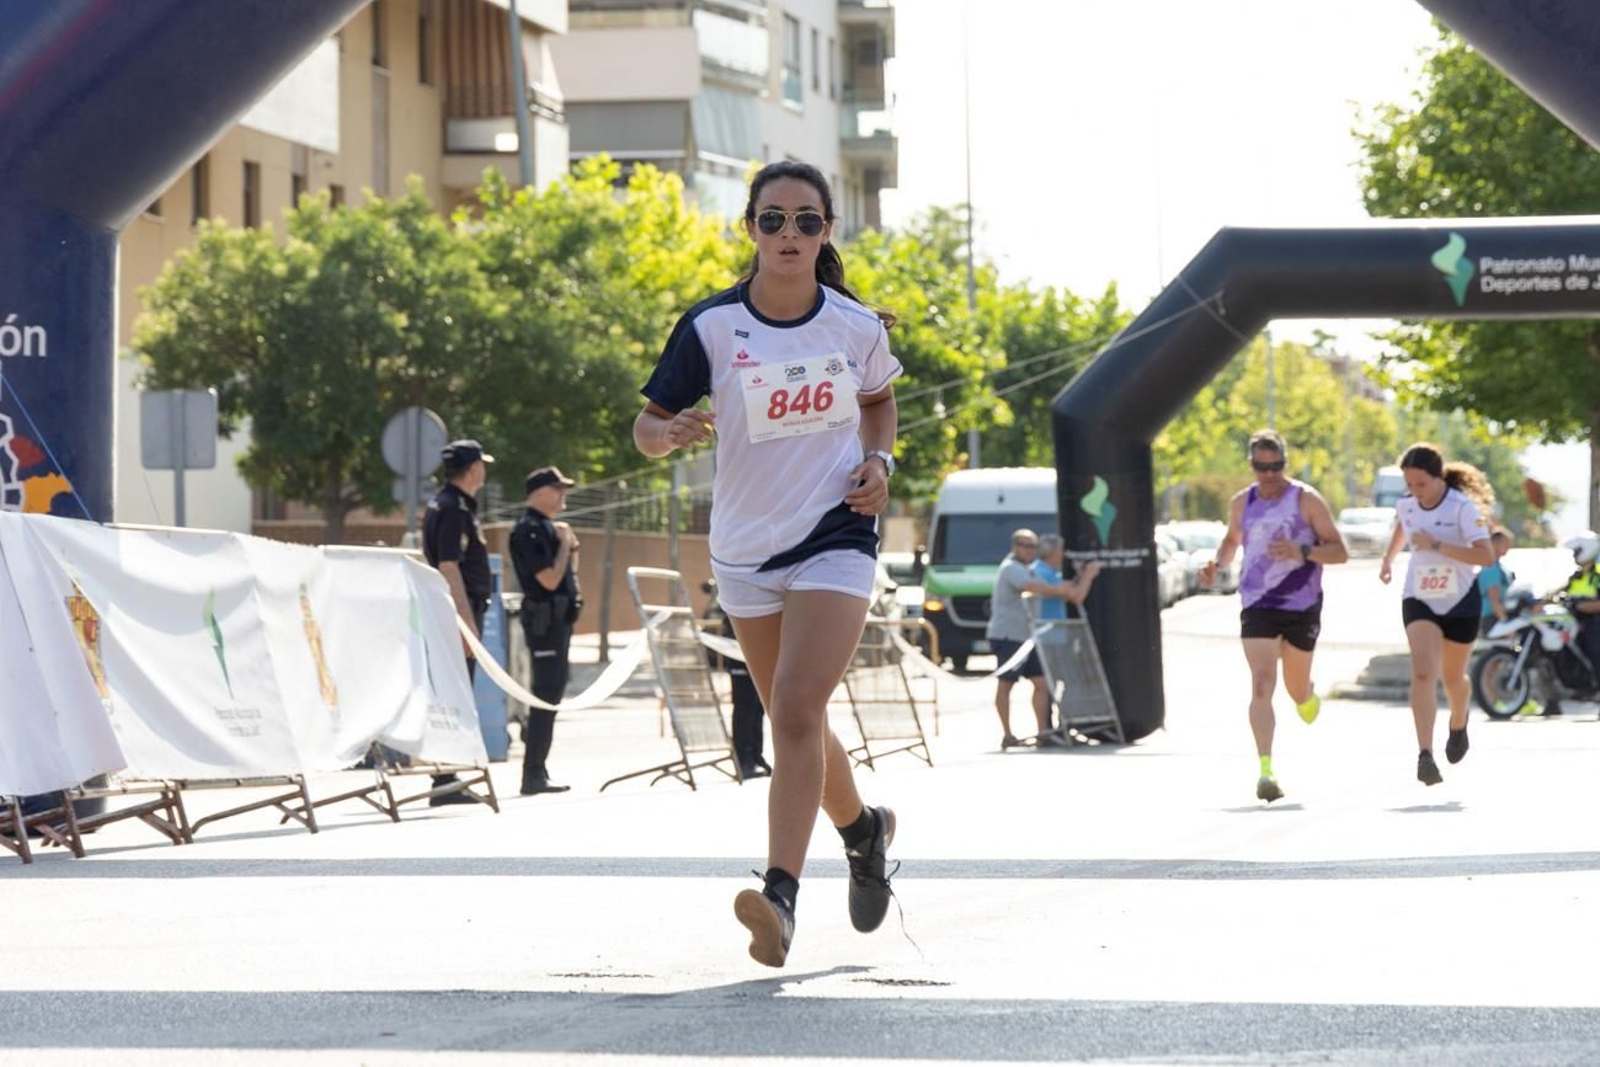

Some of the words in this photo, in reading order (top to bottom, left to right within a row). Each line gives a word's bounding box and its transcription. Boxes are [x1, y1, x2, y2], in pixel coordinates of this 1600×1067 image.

[1480, 257, 1566, 274] Patronato
[1481, 275, 1562, 295] Deportes
[1565, 273, 1589, 291] de
[0, 313, 47, 357] ón
[767, 380, 834, 420] 846
[1420, 576, 1448, 590] 802
